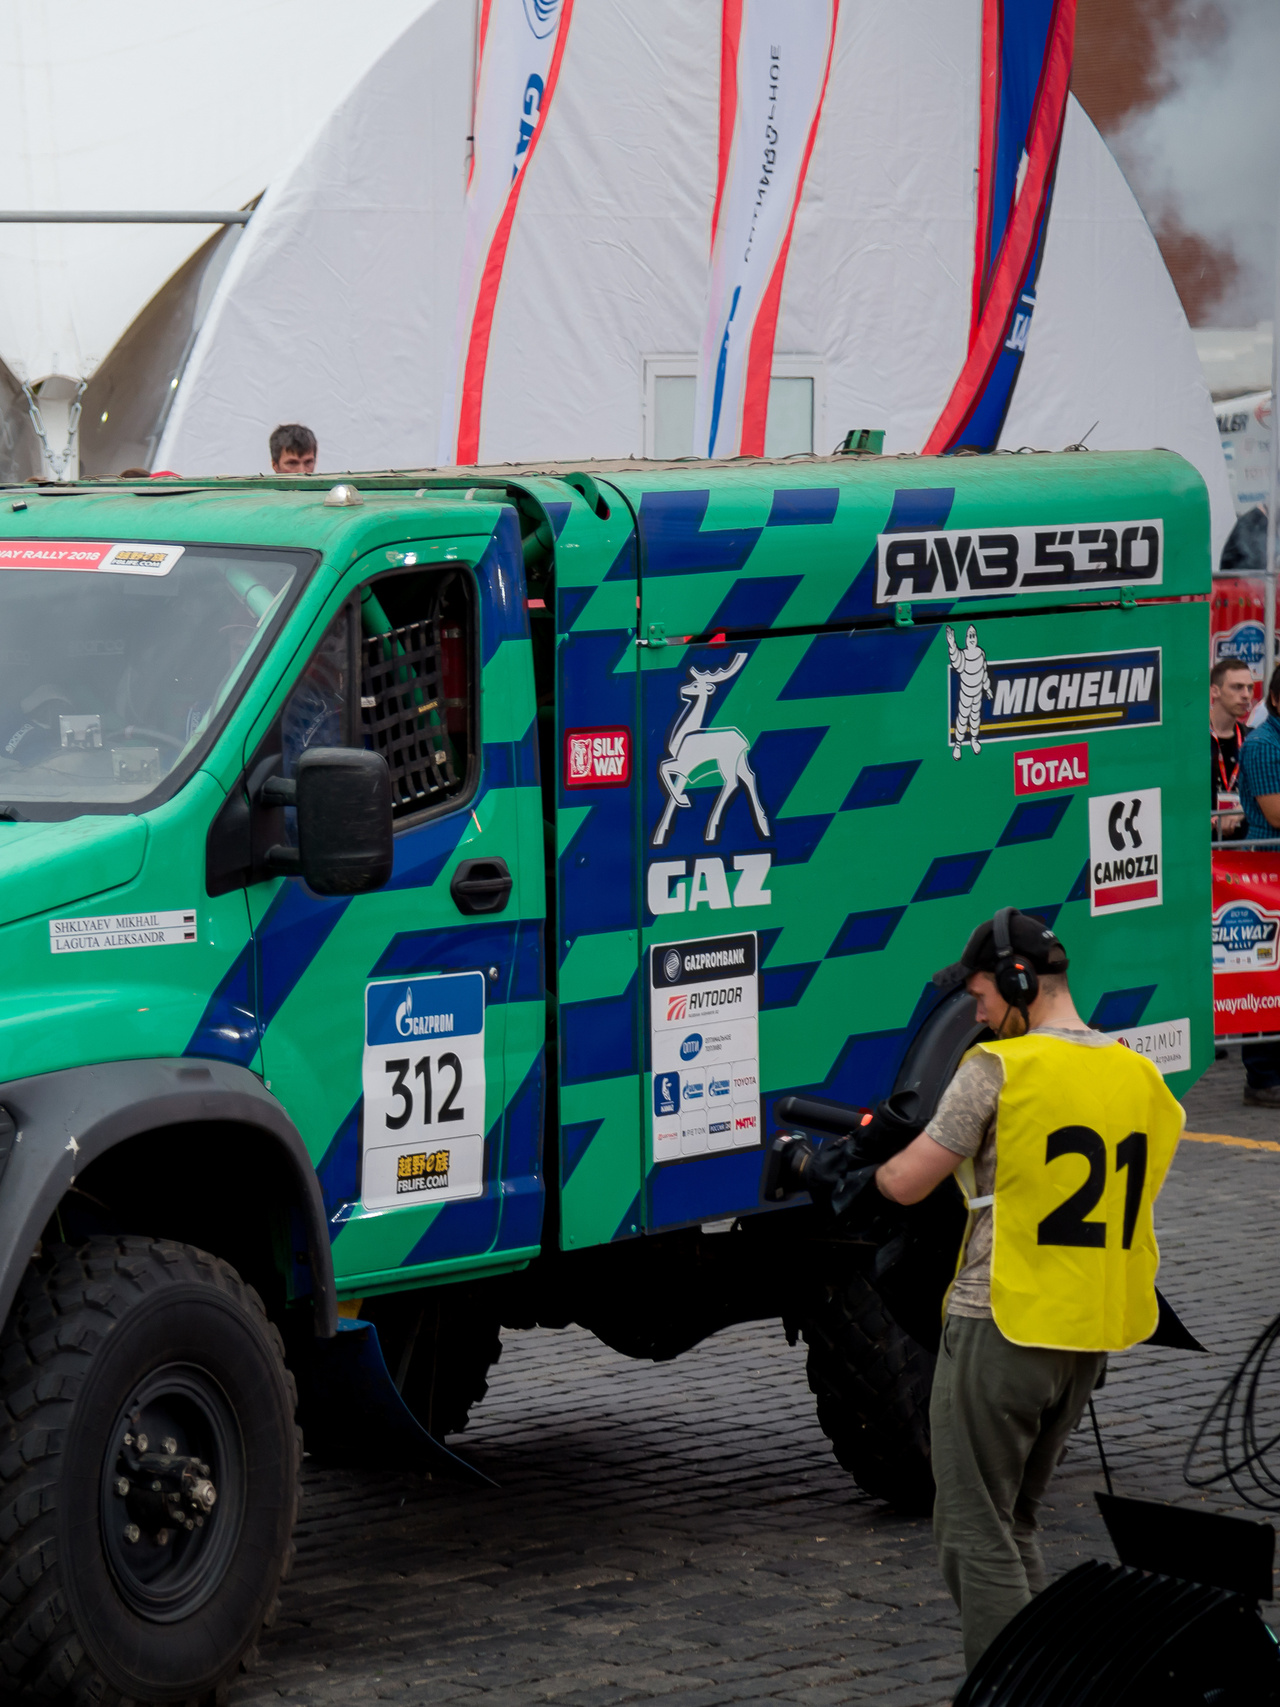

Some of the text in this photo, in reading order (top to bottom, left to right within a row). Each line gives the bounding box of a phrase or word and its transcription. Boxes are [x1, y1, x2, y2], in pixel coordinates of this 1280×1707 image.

[21, 550, 69, 560] RALLY
[68, 552, 101, 561] 2018
[1019, 526, 1160, 588] 530
[992, 667, 1154, 715] MICHELIN
[593, 736, 625, 757] SILK
[593, 756, 624, 777] WAY
[1017, 756, 1086, 787] TOTAL
[1094, 854, 1159, 885] CAMOZZI
[647, 853, 772, 915] GAZ
[55, 915, 160, 934] SHKLYAEV MIKHAIL
[1241, 924, 1274, 939] WAY
[56, 931, 166, 951] LAGUTA ALEKSANDR
[684, 948, 745, 972] GAZPROMBANK
[689, 987, 743, 1010] AVTODOR
[413, 1013, 454, 1036] GAZPROM
[385, 1052, 465, 1130] 312
[733, 1076, 757, 1088] TOYOTA
[397, 1173, 449, 1194] FBLIFE.COM
[1037, 1125, 1147, 1250] 21
